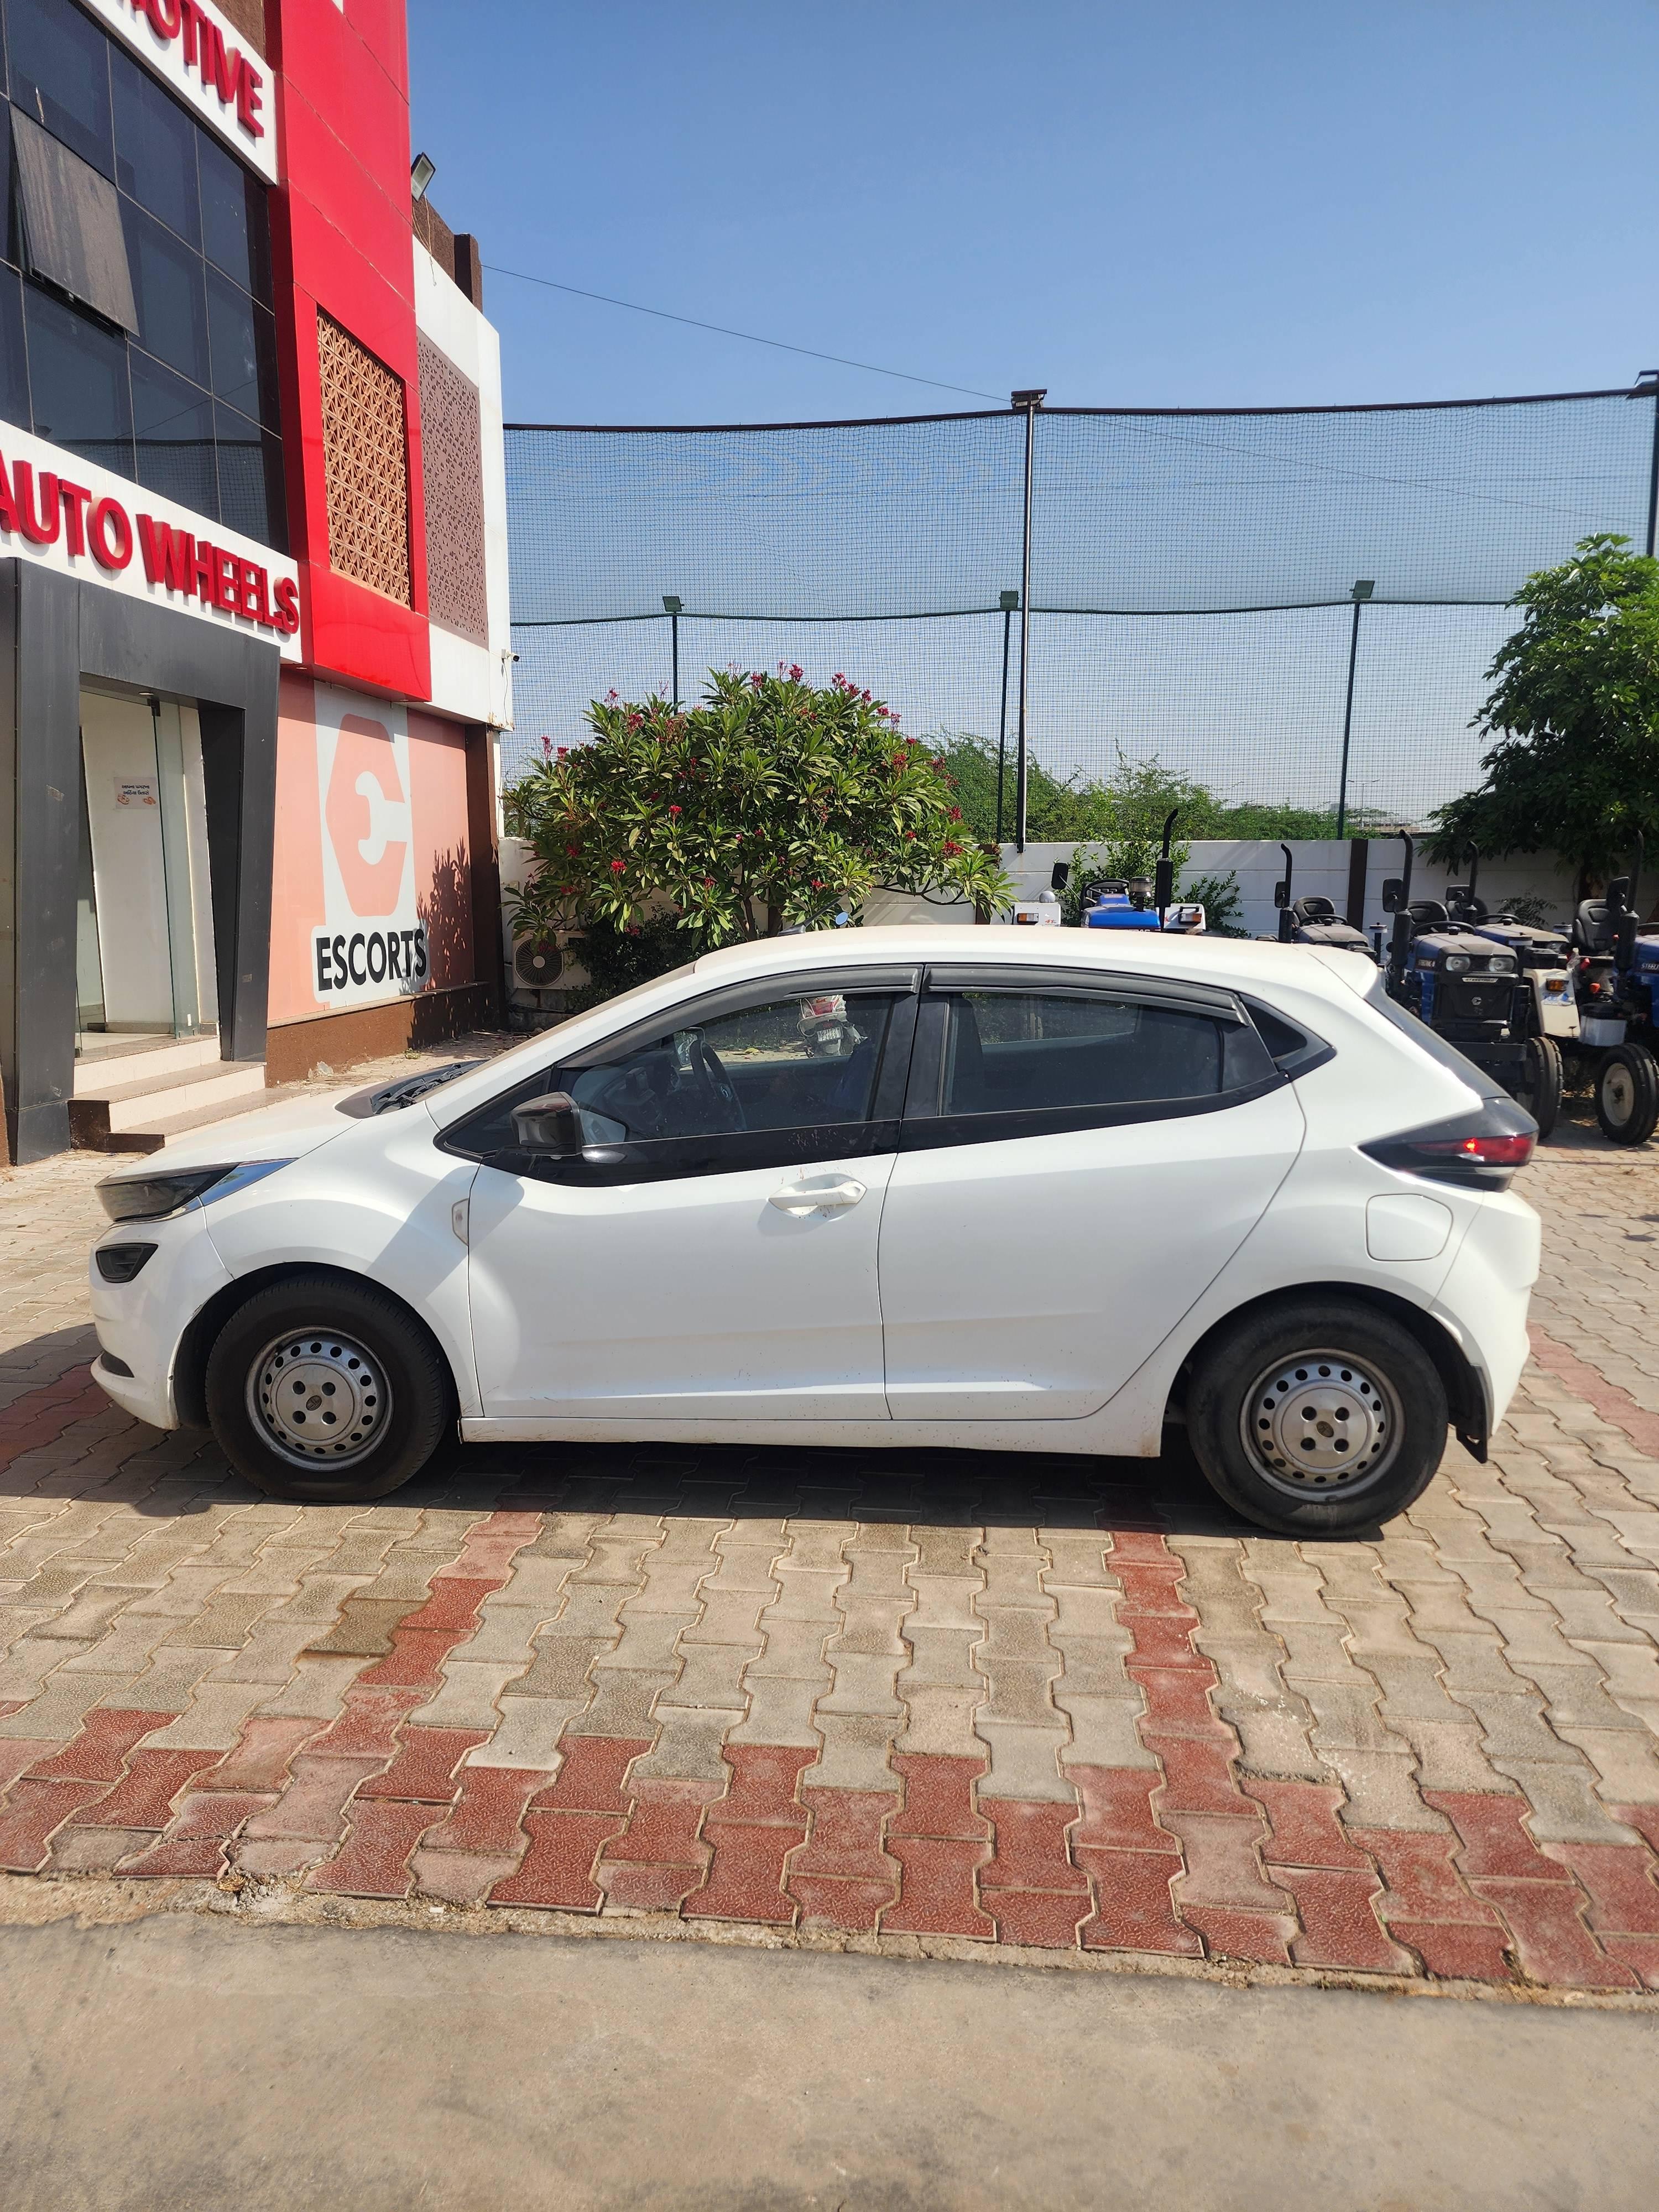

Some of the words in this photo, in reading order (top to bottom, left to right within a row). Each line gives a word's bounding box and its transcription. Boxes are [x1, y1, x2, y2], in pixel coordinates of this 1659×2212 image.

[130, 0, 264, 138] OTIVE
[136, 514, 299, 634] WHEELS
[316, 928, 427, 992] ESCORTS
